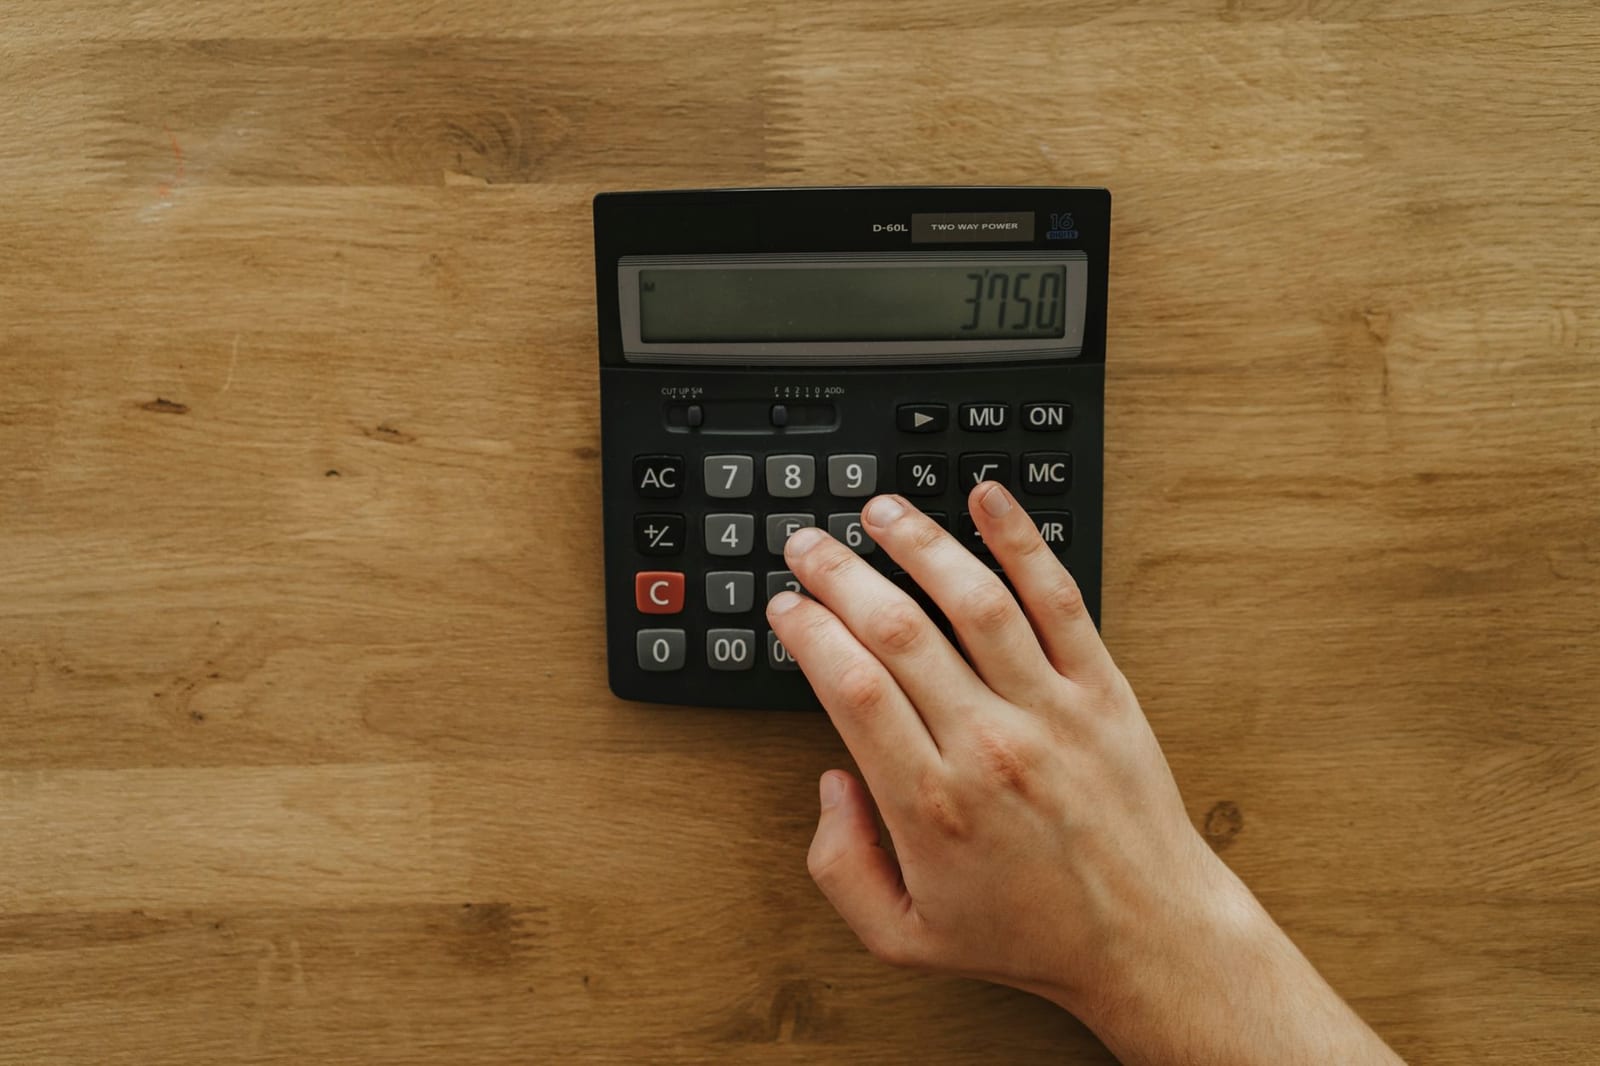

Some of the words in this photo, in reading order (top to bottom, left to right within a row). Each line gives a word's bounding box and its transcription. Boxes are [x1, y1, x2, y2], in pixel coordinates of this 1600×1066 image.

[872, 223, 909, 233] D-60L
[957, 223, 979, 231] WAY
[981, 222, 1018, 230] POWER
[1049, 212, 1074, 230] 16
[661, 387, 677, 395] CUT
[678, 387, 690, 395] UP
[969, 407, 1004, 426] MU
[1029, 407, 1063, 426] ON
[641, 468, 676, 489] AC
[722, 465, 738, 489] 7
[784, 465, 801, 489] 8
[846, 464, 862, 489] 9
[912, 464, 937, 487] %
[1028, 462, 1065, 483] MC
[720, 524, 739, 548] 4
[845, 522, 862, 547] 6
[650, 581, 669, 606] C
[725, 581, 735, 606] 1
[652, 638, 670, 662] 0
[714, 638, 747, 662] 00
